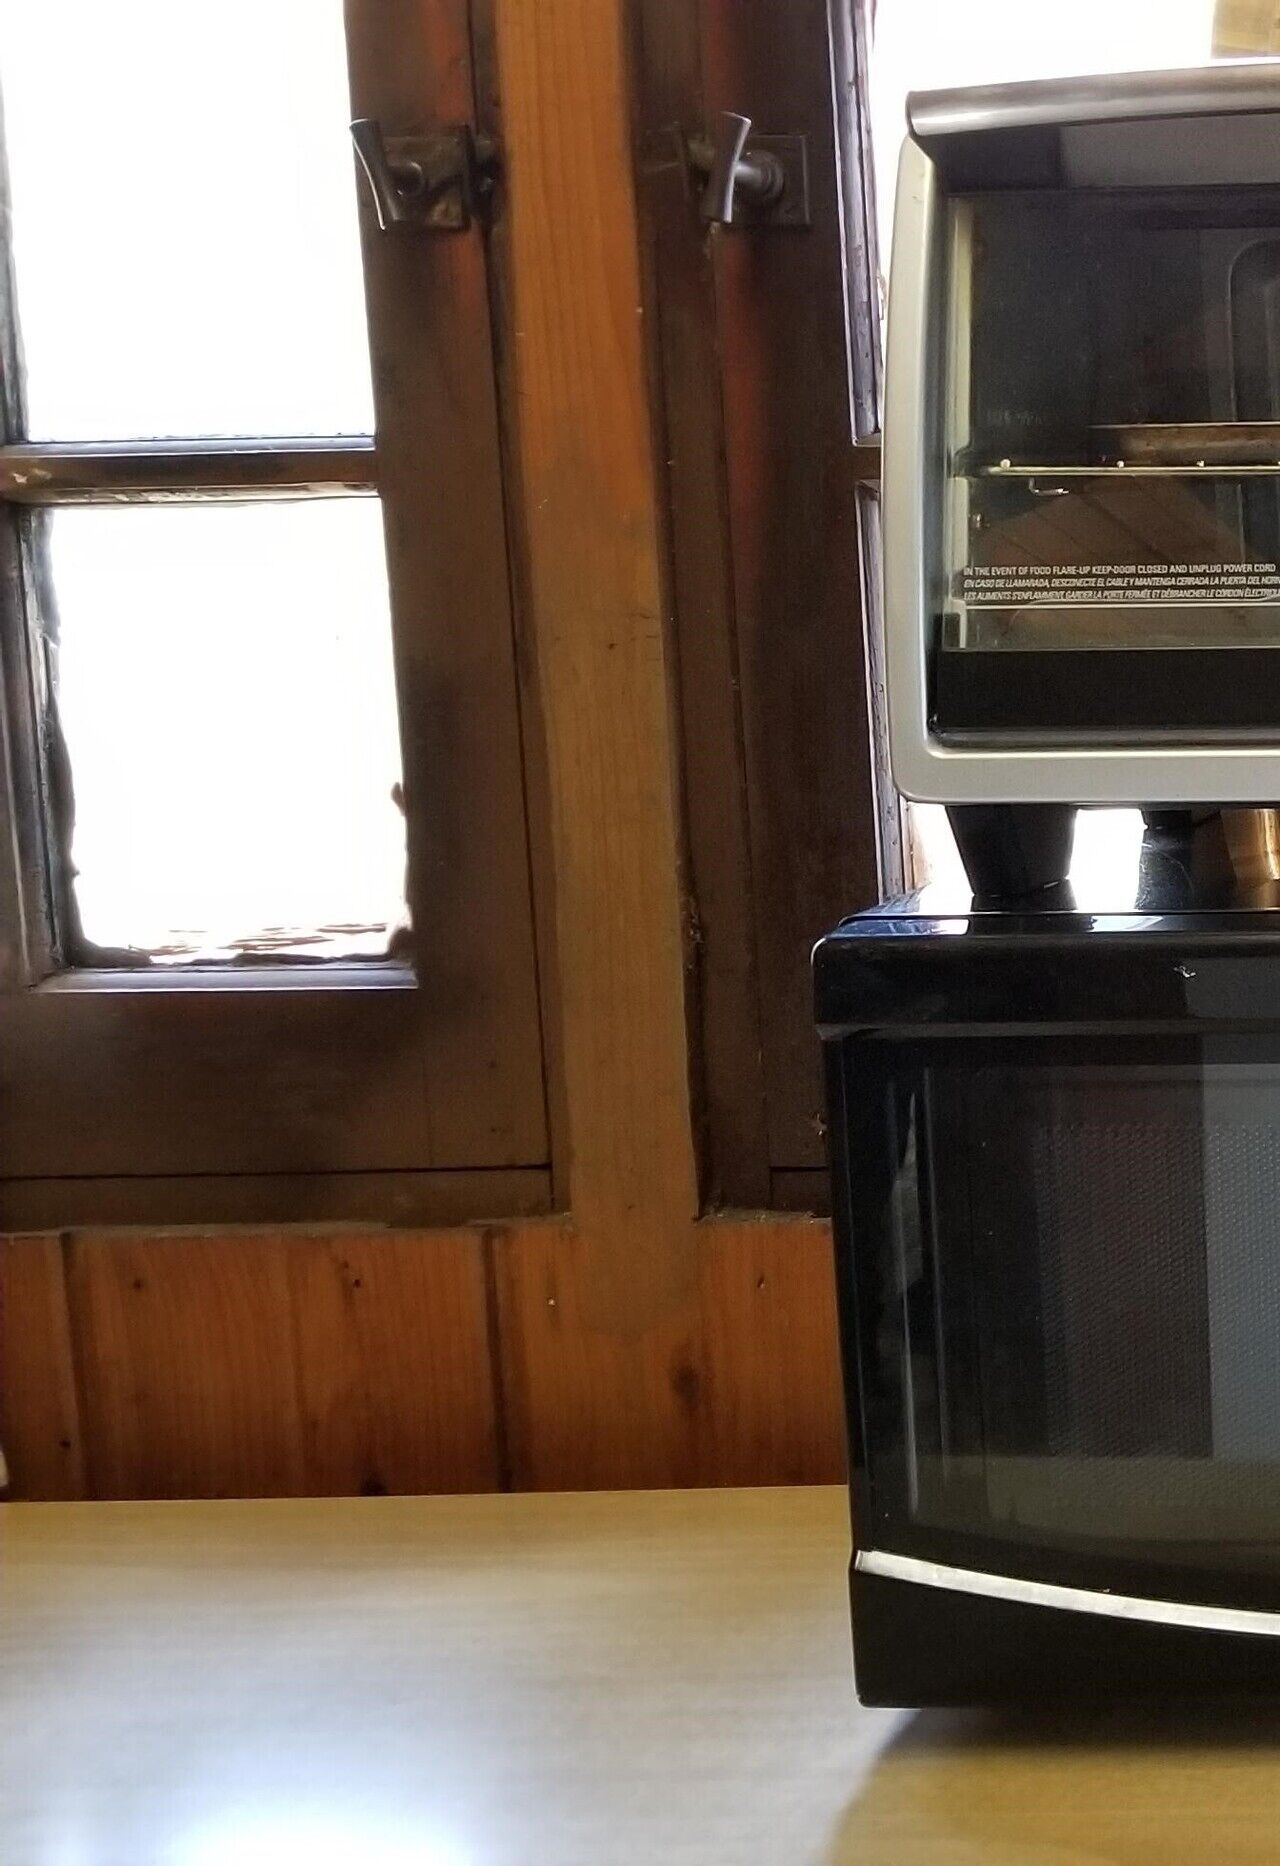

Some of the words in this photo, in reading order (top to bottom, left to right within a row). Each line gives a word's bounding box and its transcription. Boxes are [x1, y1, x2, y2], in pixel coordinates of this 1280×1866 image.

[974, 566, 990, 576] THE
[991, 566, 1017, 576] EVENT
[1018, 566, 1028, 575] OF
[1030, 566, 1051, 575] FOOD
[1052, 566, 1090, 575] FLARE-UP
[1138, 564, 1168, 574] CLOSED
[1169, 564, 1188, 574] AND
[1188, 564, 1222, 574] UNPLUG
[1223, 564, 1253, 573] POWER
[1254, 564, 1276, 572] CORD
